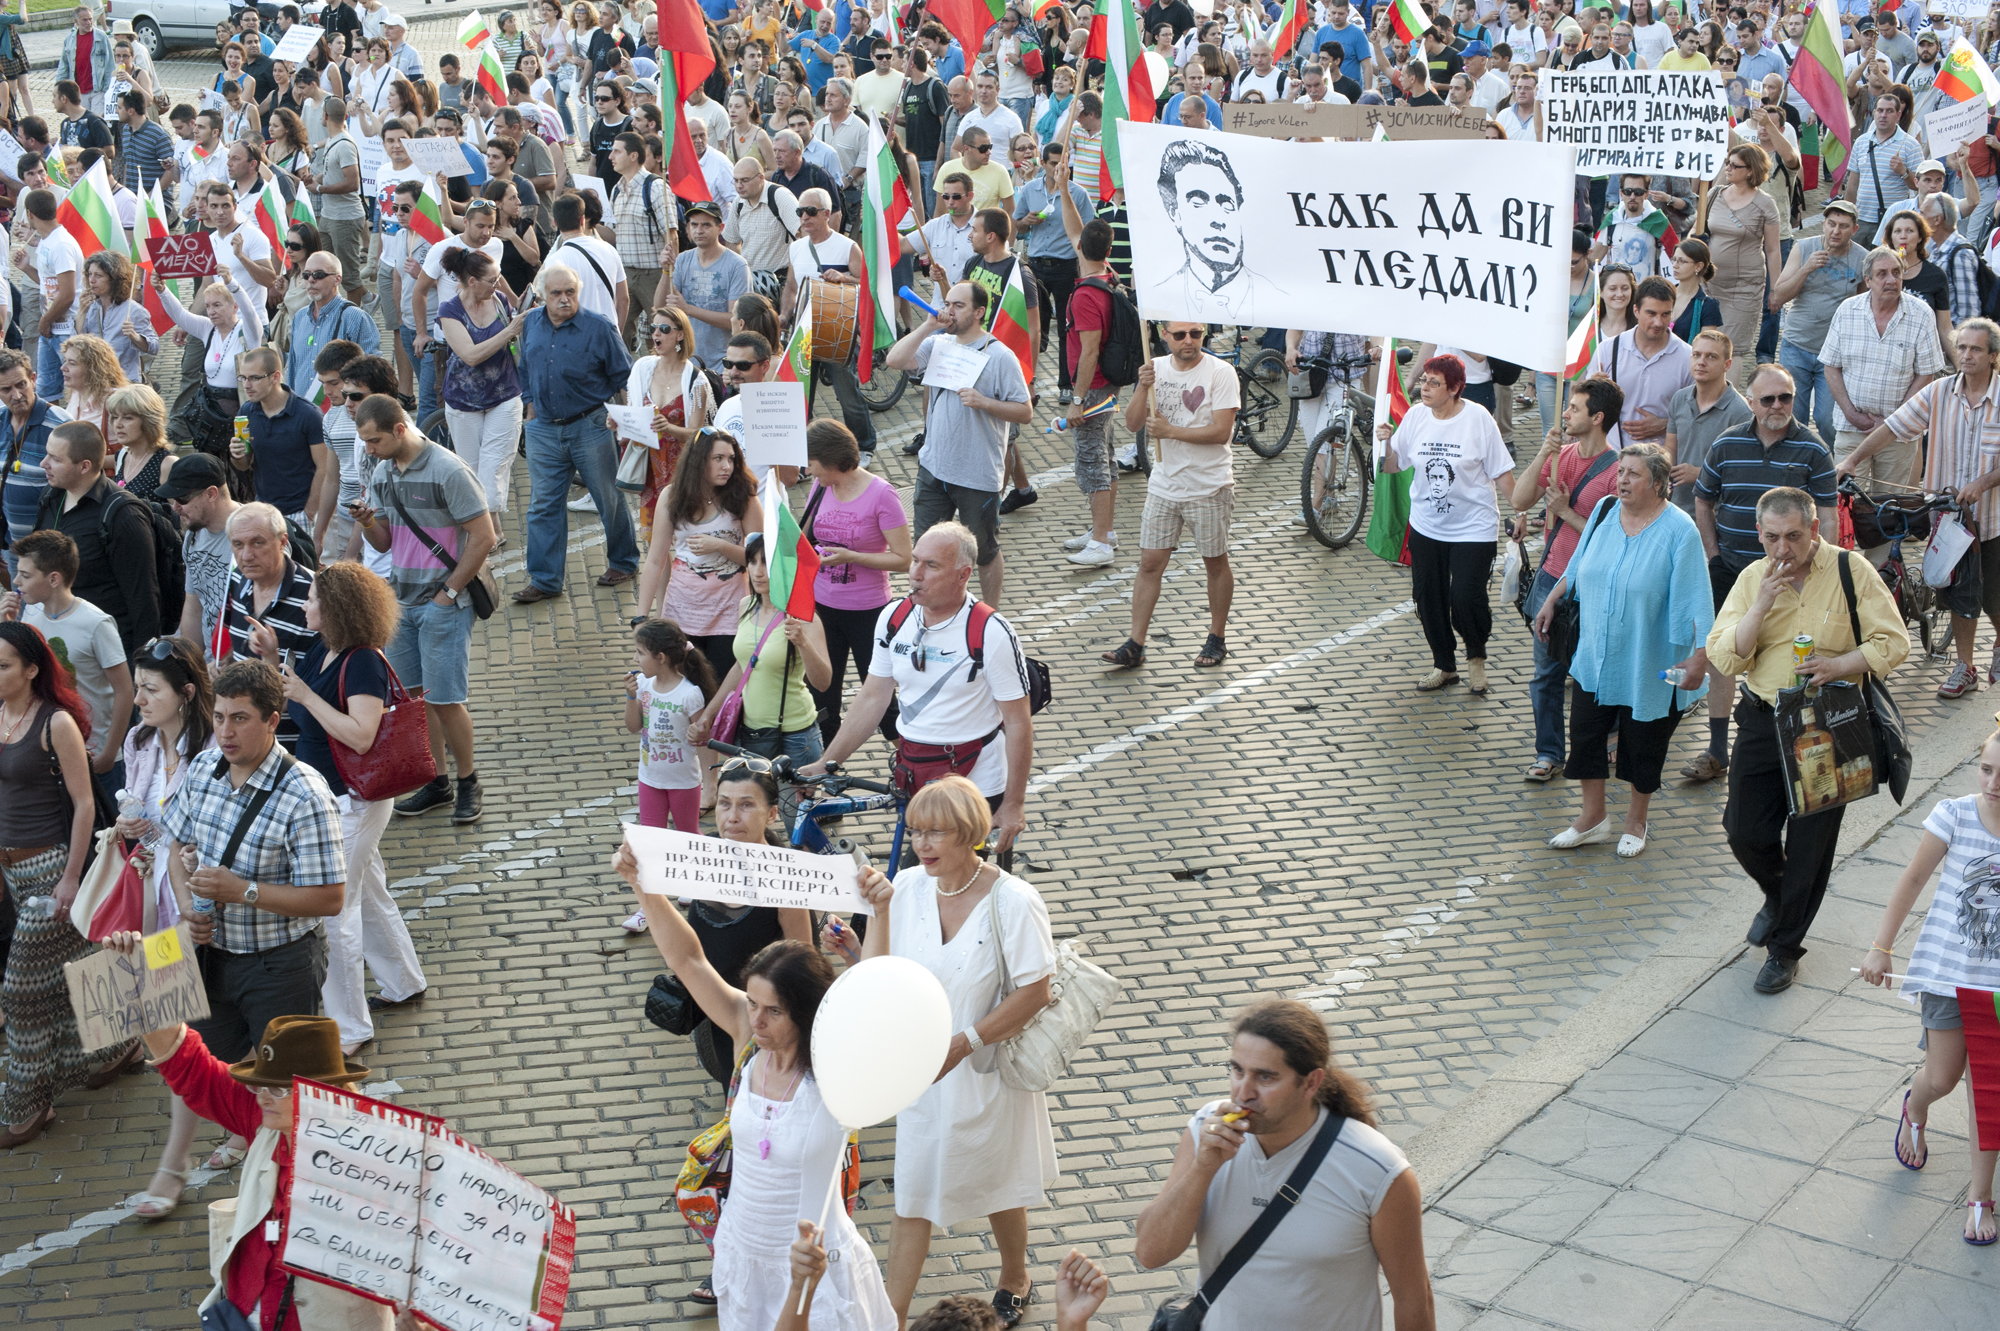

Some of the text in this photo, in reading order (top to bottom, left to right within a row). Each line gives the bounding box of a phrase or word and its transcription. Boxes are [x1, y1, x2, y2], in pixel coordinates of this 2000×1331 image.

[1232, 111, 1275, 128] #Ignore
[1549, 99, 1728, 122] БЪЛГАРИЯ ЗАСЛУЖАВА
[0, 133, 23, 159] ОСТ
[1547, 126, 1600, 143] МНОГО
[1607, 125, 1665, 143] ПОВЕЧЕ
[1695, 129, 1724, 143] ВАС
[1576, 146, 1714, 173] ИГРИРАЙТЕ ВИЕ
[1286, 192, 1554, 248] КАК ДА ВИ
[155, 233, 199, 254] NO
[153, 249, 214, 274] MERCY
[1318, 248, 1538, 312] ГЛЕДАМ?
[893, 643, 911, 656] NIKE
[651, 697, 684, 713] Always
[688, 840, 796, 863] НЕ ИСКАМЕ
[664, 867, 688, 880] НА
[665, 852, 834, 881] ПРАВИТЕЛСТВОТО
[716, 888, 809, 906] АХМЕД ДОГАН!
[304, 1117, 445, 1172] ВЕЛИКО
[312, 1150, 448, 1207] СЪБРАНИЕ
[459, 1171, 546, 1222] НАРОДНО
[310, 1189, 344, 1212] НИ
[357, 1206, 471, 1264] ОБЕДЕНИ
[459, 1211, 489, 1231] ЗА
